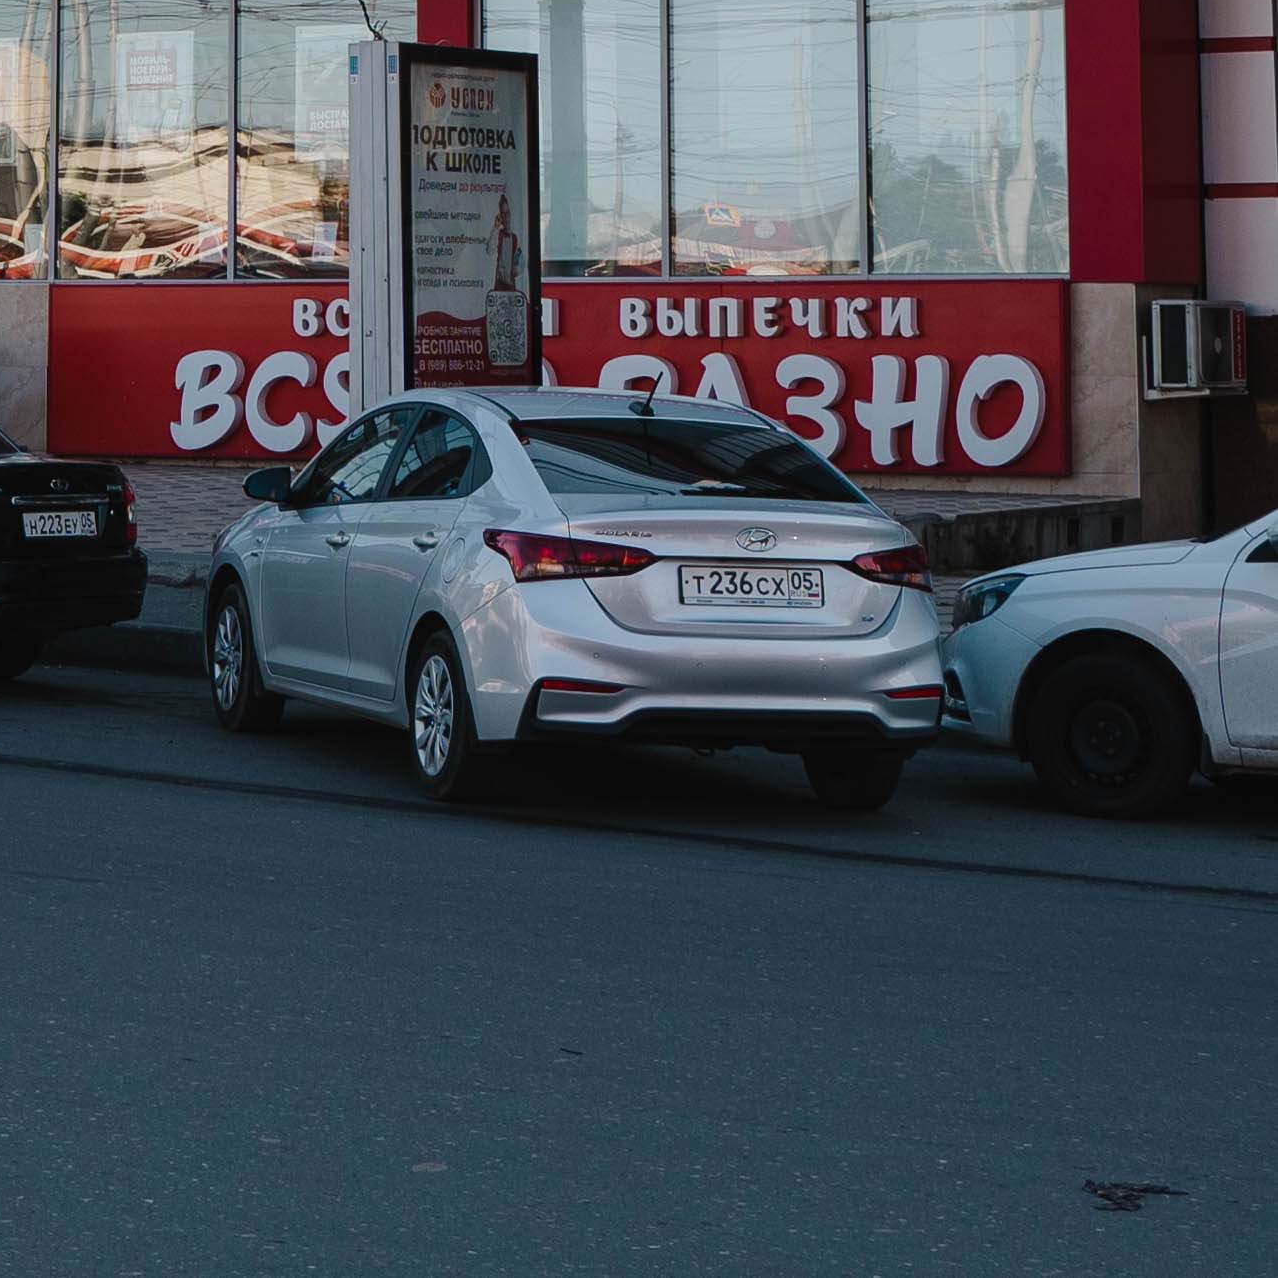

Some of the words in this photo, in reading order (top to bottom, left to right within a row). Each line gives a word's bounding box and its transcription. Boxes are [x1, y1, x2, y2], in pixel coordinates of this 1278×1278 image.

[426, 152, 439, 172] К
[446, 152, 502, 175] ШКОЛЕ
[620, 297, 920, 339] ВЫПЕЧКИ
[30, 514, 79, 535] Н223ЕУ
[692, 570, 786, 597] Т236СХ
[790, 572, 813, 591] 05
